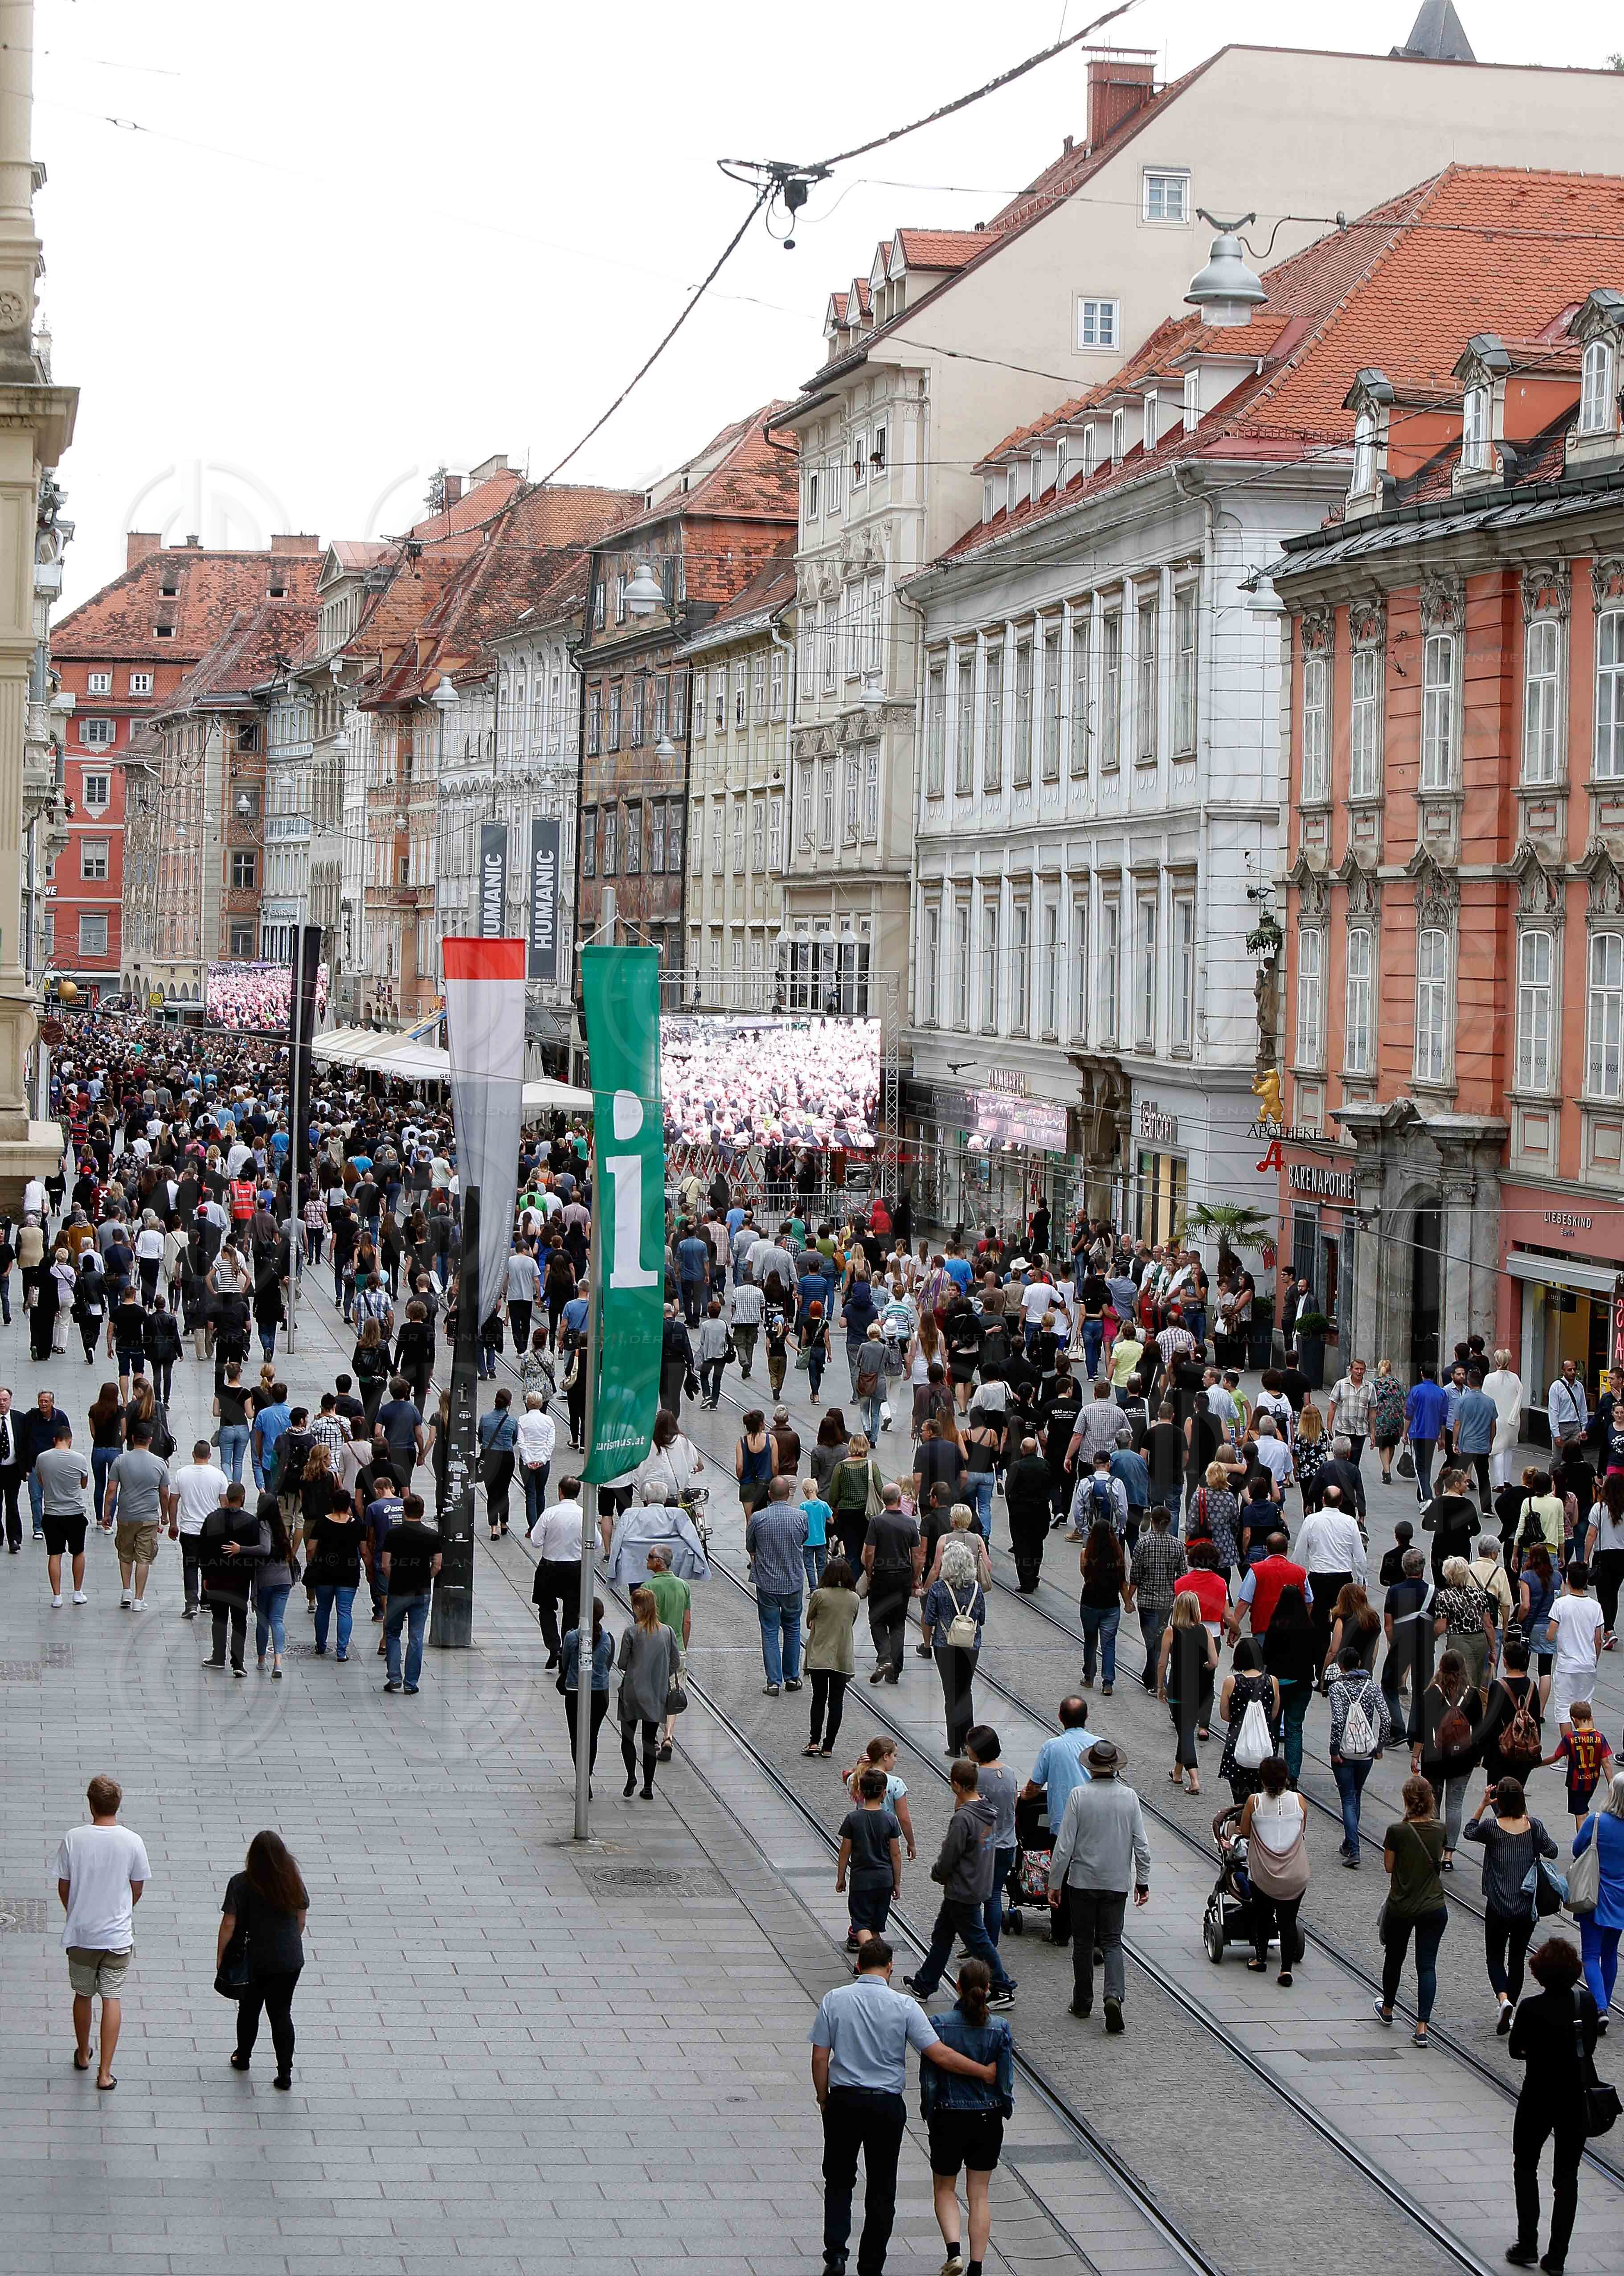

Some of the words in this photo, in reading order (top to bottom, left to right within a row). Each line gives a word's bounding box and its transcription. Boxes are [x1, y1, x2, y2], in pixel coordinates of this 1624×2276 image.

[535, 850, 554, 949] HUMANIC
[1248, 1124, 1322, 1140] APOTHEKE
[1544, 1212, 1592, 1229] LIEBESKIND
[1570, 1736, 1594, 1744] NEYMAR
[1576, 1745, 1595, 1769] 11
